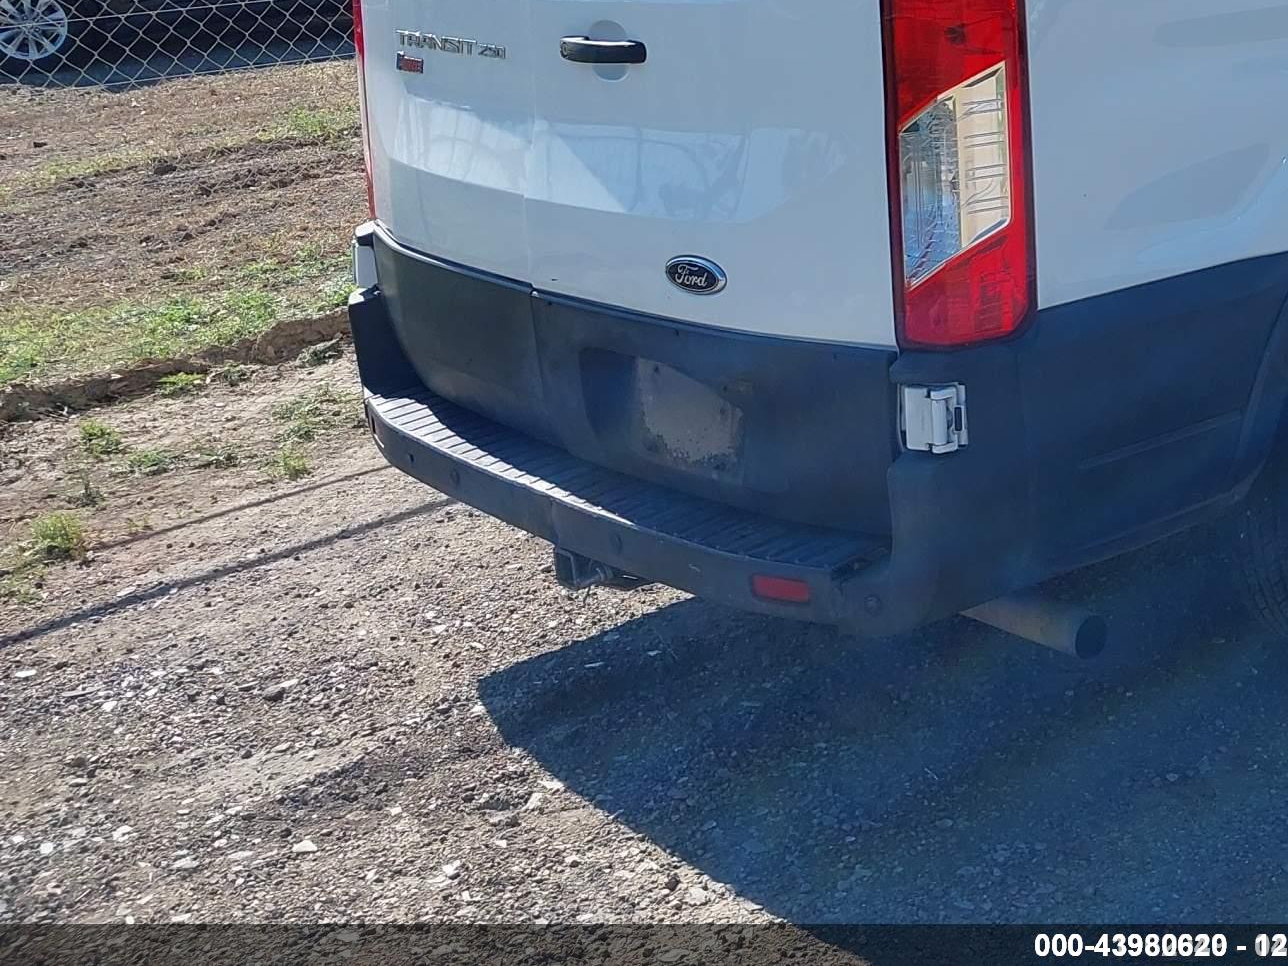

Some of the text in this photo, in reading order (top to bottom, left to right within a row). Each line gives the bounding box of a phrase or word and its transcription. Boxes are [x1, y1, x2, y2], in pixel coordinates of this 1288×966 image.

[395, 29, 506, 59] TRANSIT 250
[674, 263, 708, 287] Ford
